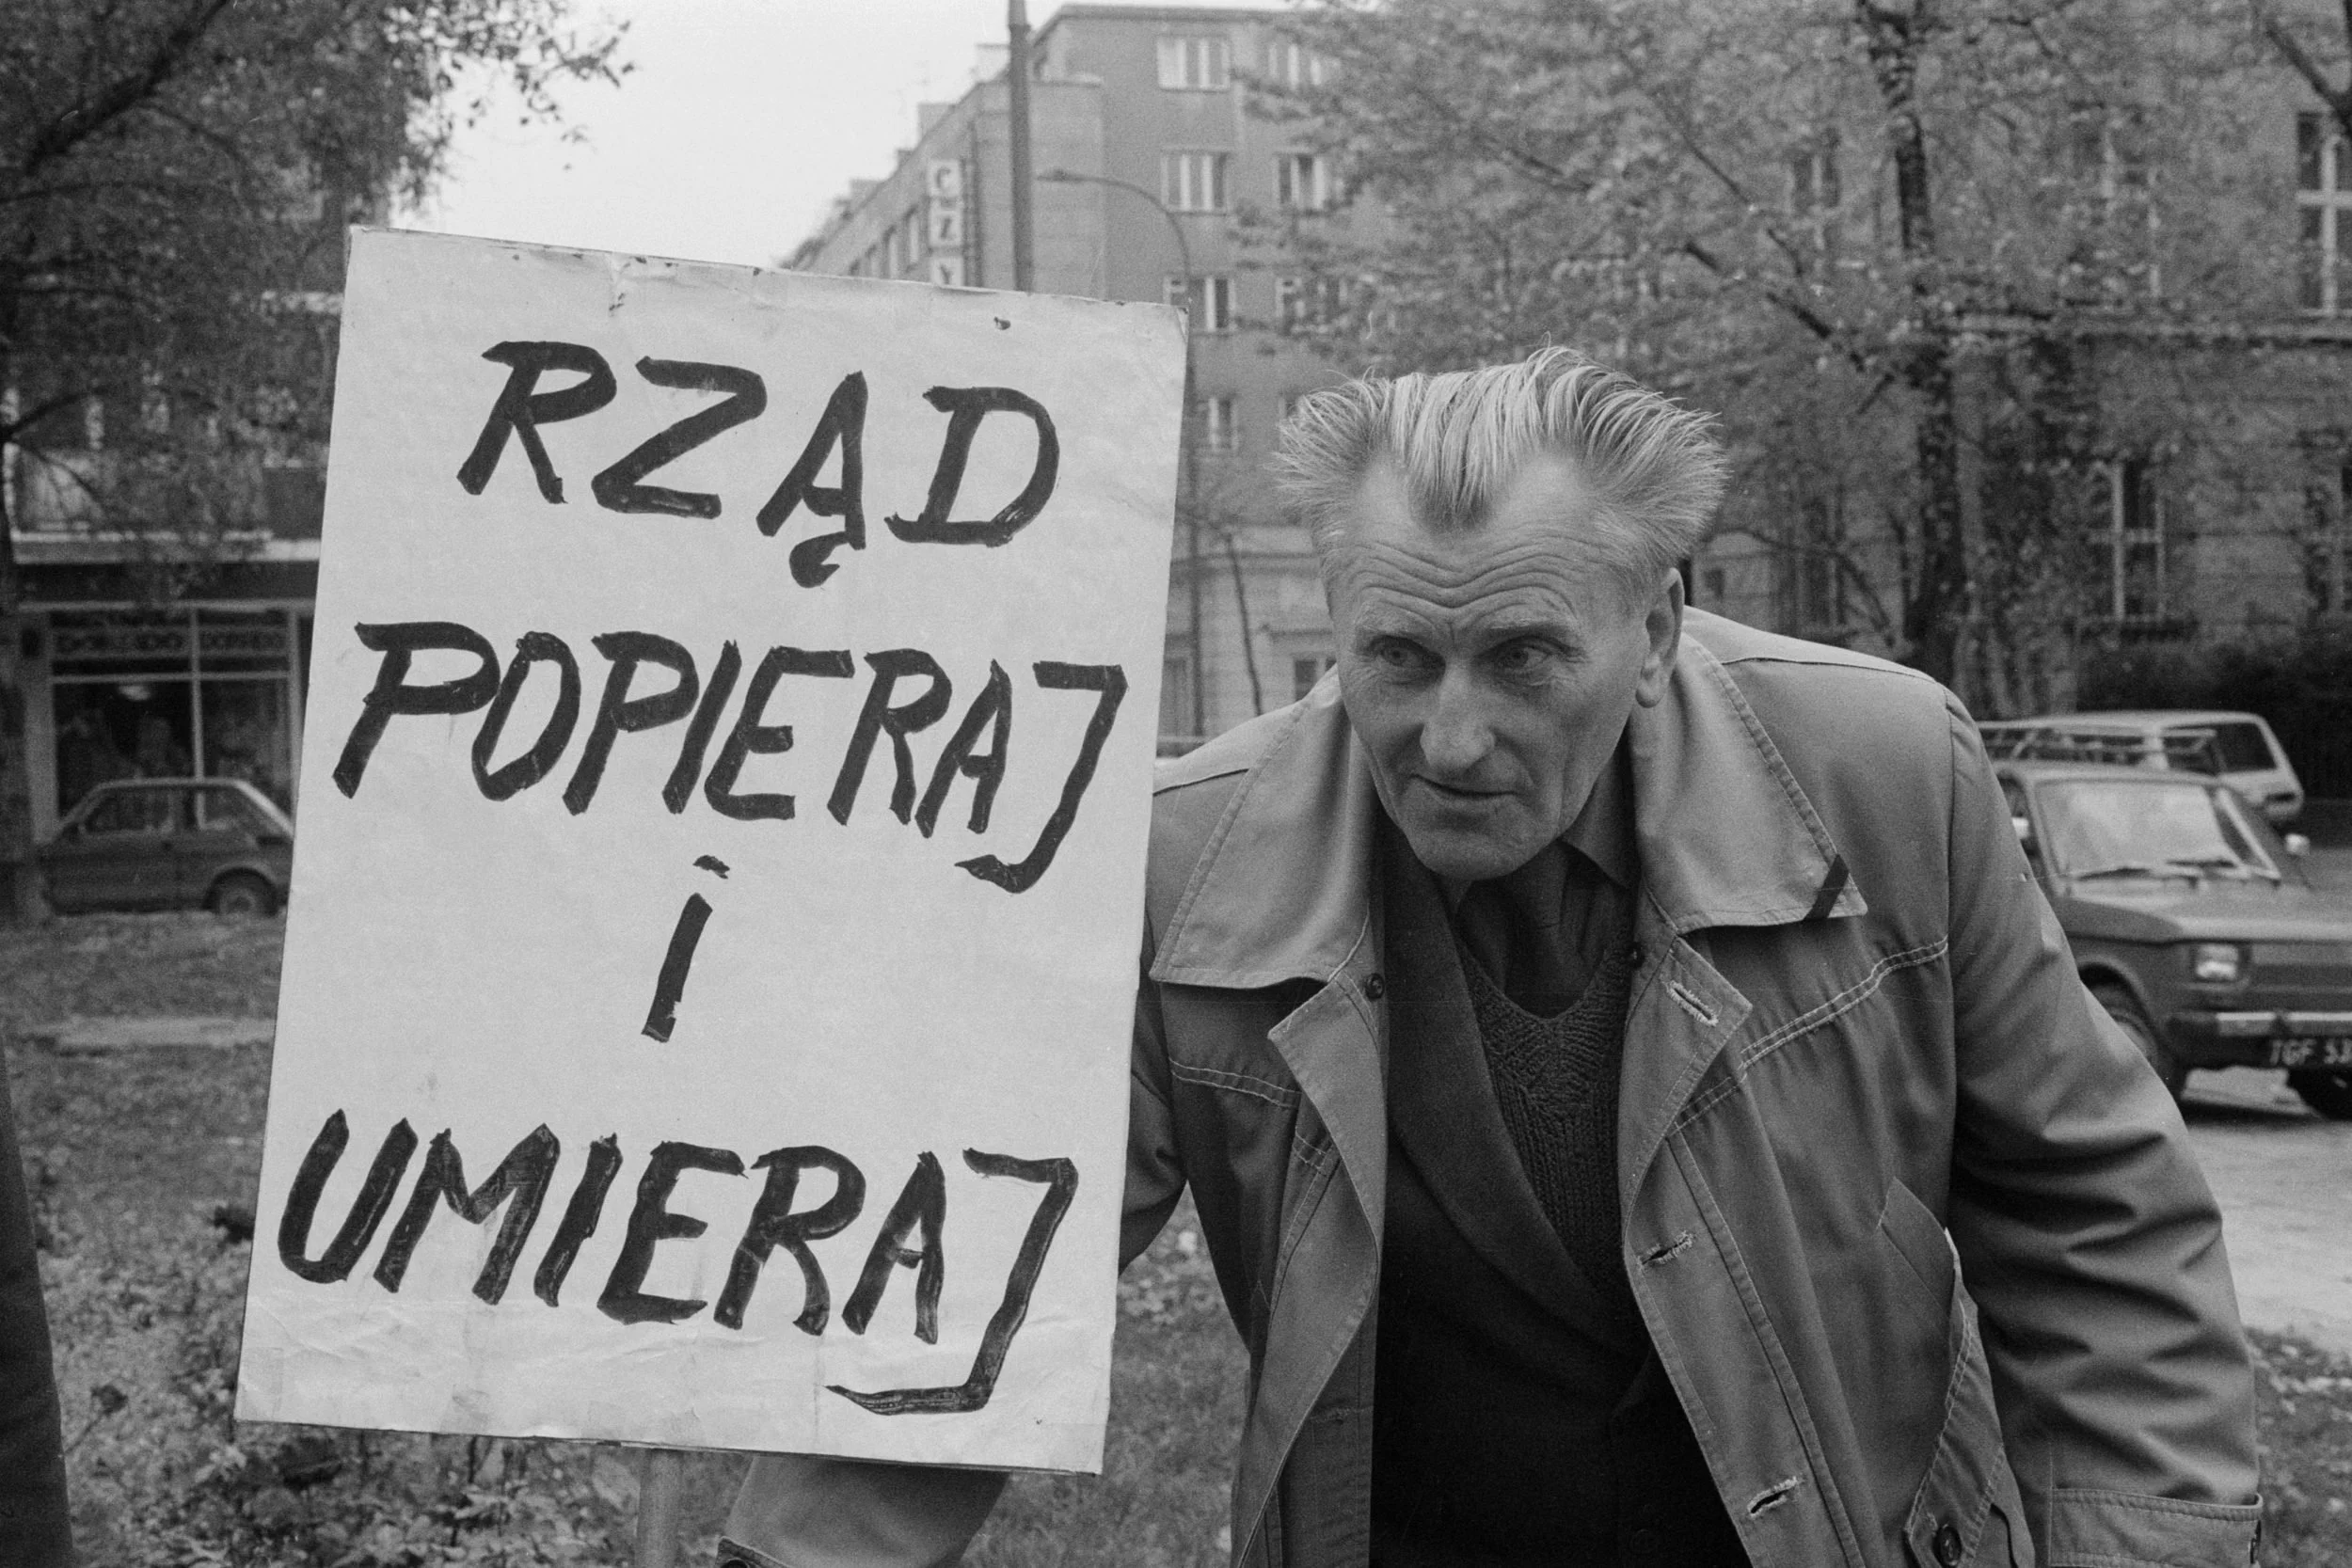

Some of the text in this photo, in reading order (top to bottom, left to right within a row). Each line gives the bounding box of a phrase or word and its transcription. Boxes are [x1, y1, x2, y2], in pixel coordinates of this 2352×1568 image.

[457, 341, 1059, 589] RZĄD
[333, 621, 1128, 894] POPIERAJ
[278, 1108, 1079, 1417] UMIERAJ
